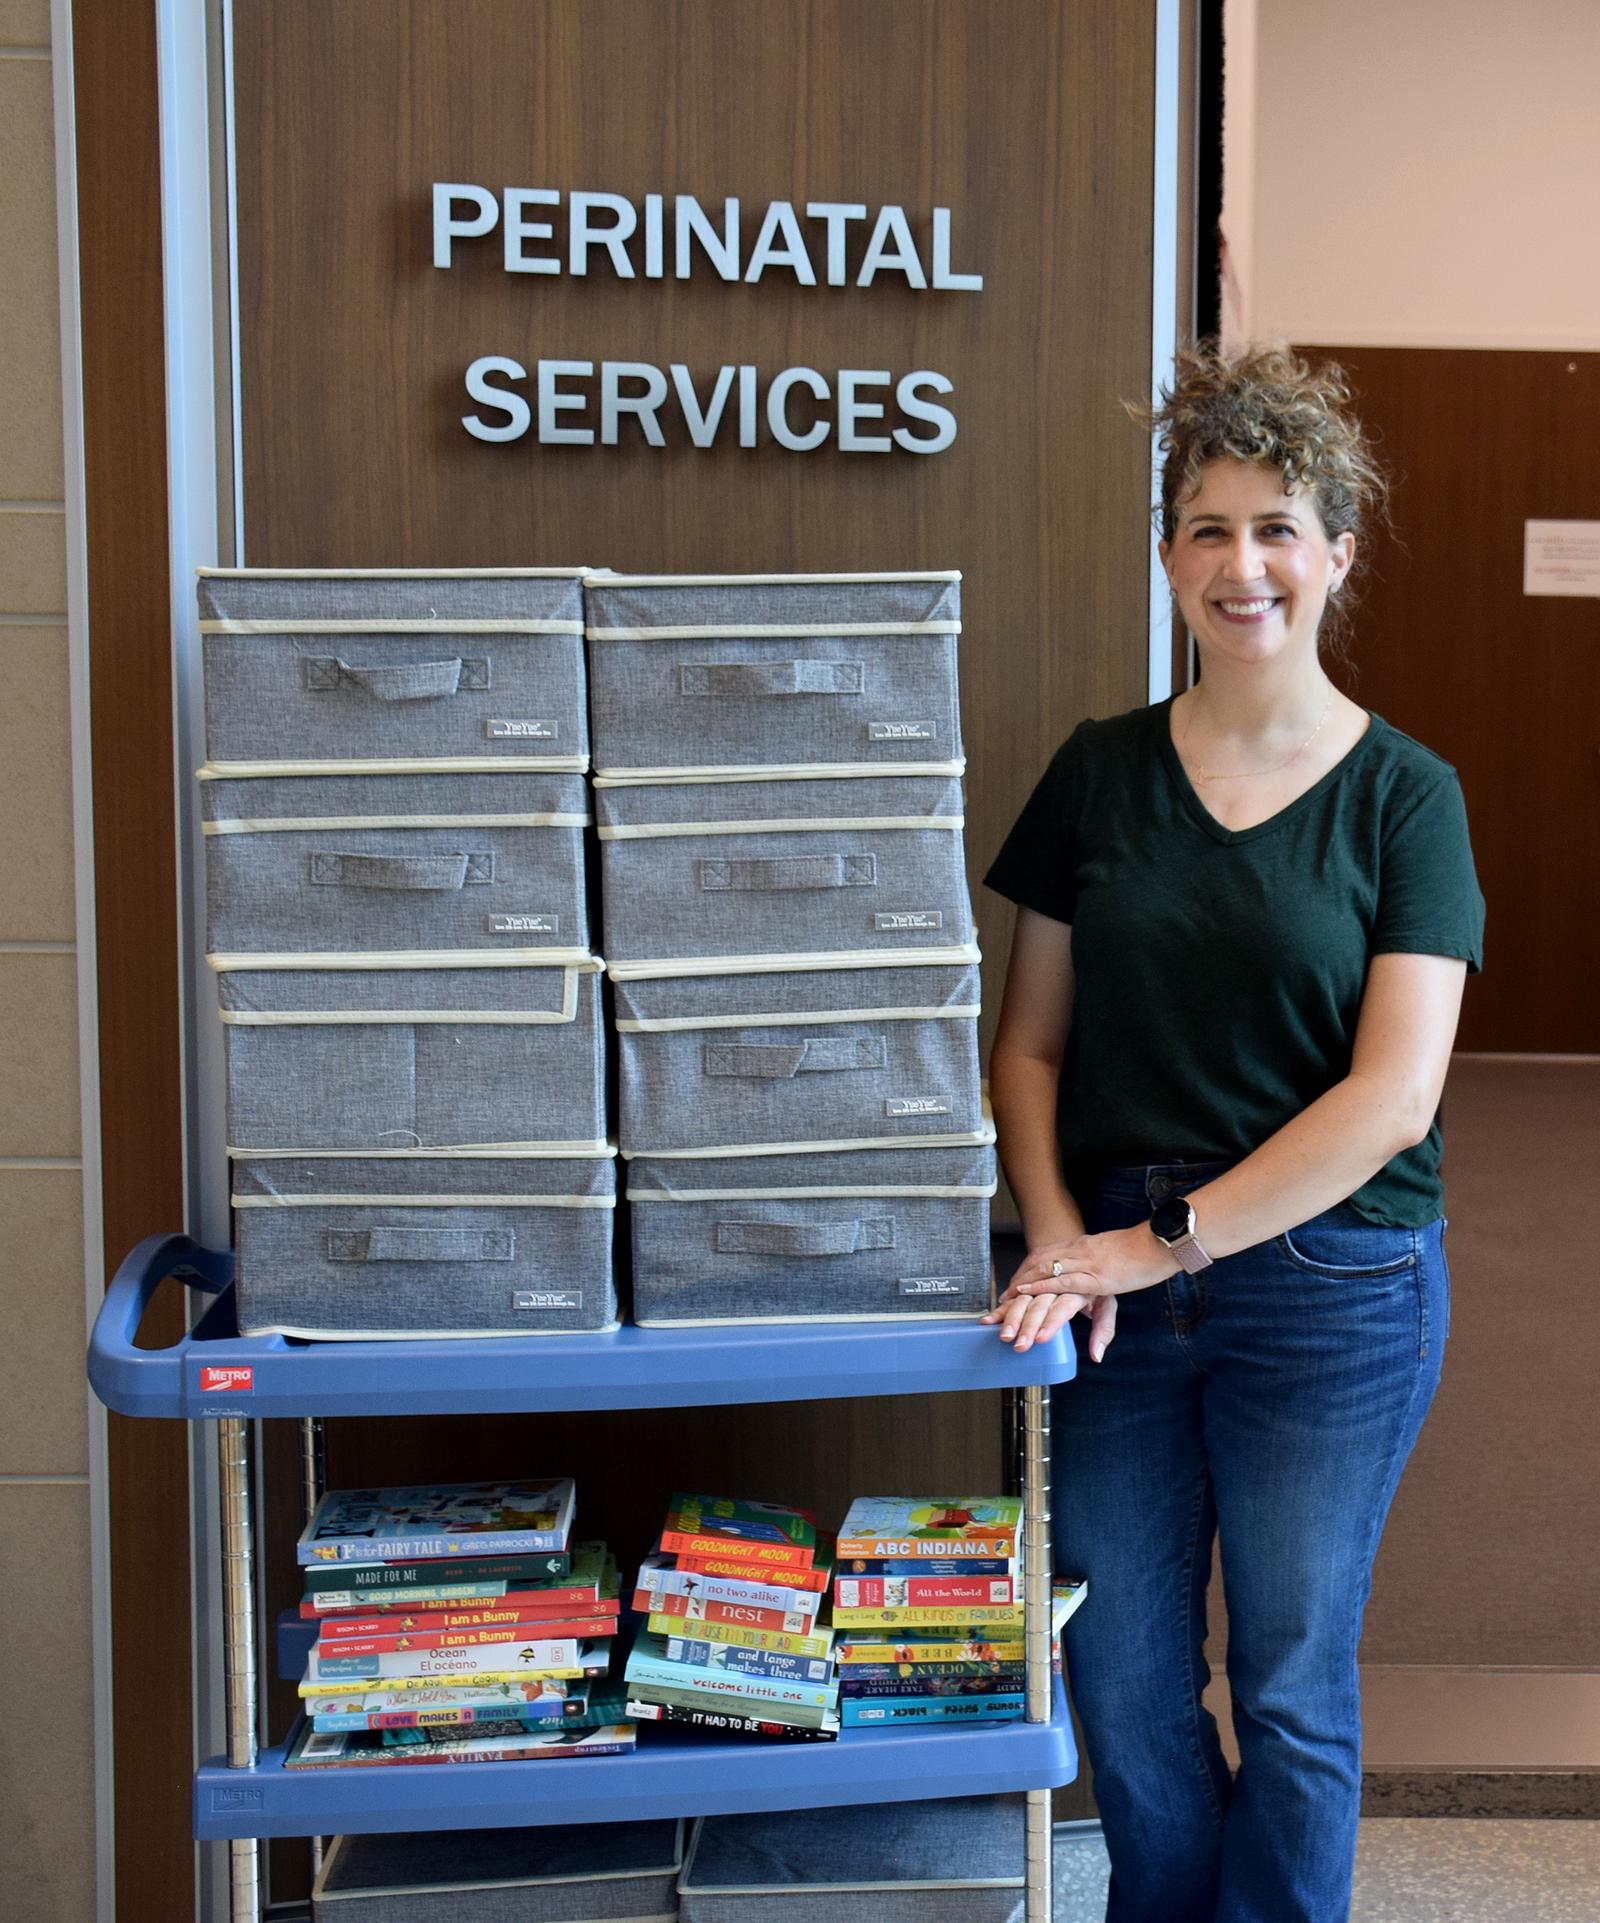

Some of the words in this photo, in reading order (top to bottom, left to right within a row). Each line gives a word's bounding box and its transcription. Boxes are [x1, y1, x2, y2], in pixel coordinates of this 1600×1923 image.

[433, 183, 983, 291] PERINATAL
[462, 356, 957, 454] SERVICES
[208, 1369, 251, 1381] METRO
[378, 1542, 412, 1557] FAIRY
[415, 1540, 443, 1555] TALE
[690, 1539, 756, 1557] GOODNIGHT
[758, 1548, 793, 1561] MOON
[874, 1542, 911, 1555] ABC
[916, 1541, 989, 1555] INDIANA
[355, 1571, 381, 1584] MADE
[384, 1570, 400, 1583] FOR
[403, 1569, 417, 1581] ME
[704, 1561, 770, 1578] GOODNIGHT
[772, 1572, 807, 1585] MOON
[368, 1591, 394, 1601] GOOD
[707, 1585, 723, 1594] no
[726, 1587, 748, 1598] two
[751, 1590, 780, 1603] alike
[916, 1588, 932, 1597] All
[935, 1588, 951, 1597] the
[952, 1587, 982, 1597] World
[428, 1600, 447, 1608] am
[449, 1599, 458, 1608] a
[460, 1597, 497, 1609] Bunny
[444, 1615, 448, 1625] I
[450, 1615, 470, 1625] am
[472, 1614, 481, 1622] a
[483, 1611, 520, 1622] Bunny
[721, 1604, 766, 1622] nest
[903, 1610, 918, 1621] ALL
[923, 1608, 955, 1621] KINDS
[969, 1607, 1015, 1620] FAMILIES
[440, 1635, 444, 1645] I
[447, 1635, 466, 1645] am
[468, 1634, 477, 1643] a
[479, 1631, 517, 1643] Bunny
[682, 1620, 722, 1639] BECAUSE
[743, 1630, 768, 1647] YOUR
[773, 1635, 792, 1649] DAD
[429, 1648, 467, 1659] Ocean
[737, 1650, 759, 1661] and
[921, 1648, 953, 1658] BEE
[420, 1661, 431, 1671] El
[434, 1660, 478, 1670] océano
[727, 1661, 766, 1675] makes
[770, 1667, 802, 1681] three
[916, 1663, 965, 1676] OCEAN
[692, 1678, 743, 1692] welcome
[746, 1684, 777, 1697] little
[783, 1691, 803, 1700] one
[900, 1685, 924, 1693] TAKE
[893, 1707, 927, 1717] black
[944, 1704, 979, 1715] gifted
[985, 1702, 1024, 1712] young
[385, 1714, 412, 1726] LOVE
[418, 1711, 458, 1724] MAKES
[463, 1710, 472, 1721] A
[476, 1706, 520, 1720] FAMILY
[692, 1713, 704, 1724] IT
[705, 1715, 727, 1727] HAD
[728, 1717, 742, 1729] TO
[744, 1720, 760, 1732] BE
[760, 1721, 785, 1735] YOU
[447, 1750, 505, 1764] FAMILY
[221, 1787, 262, 1801] METRO
